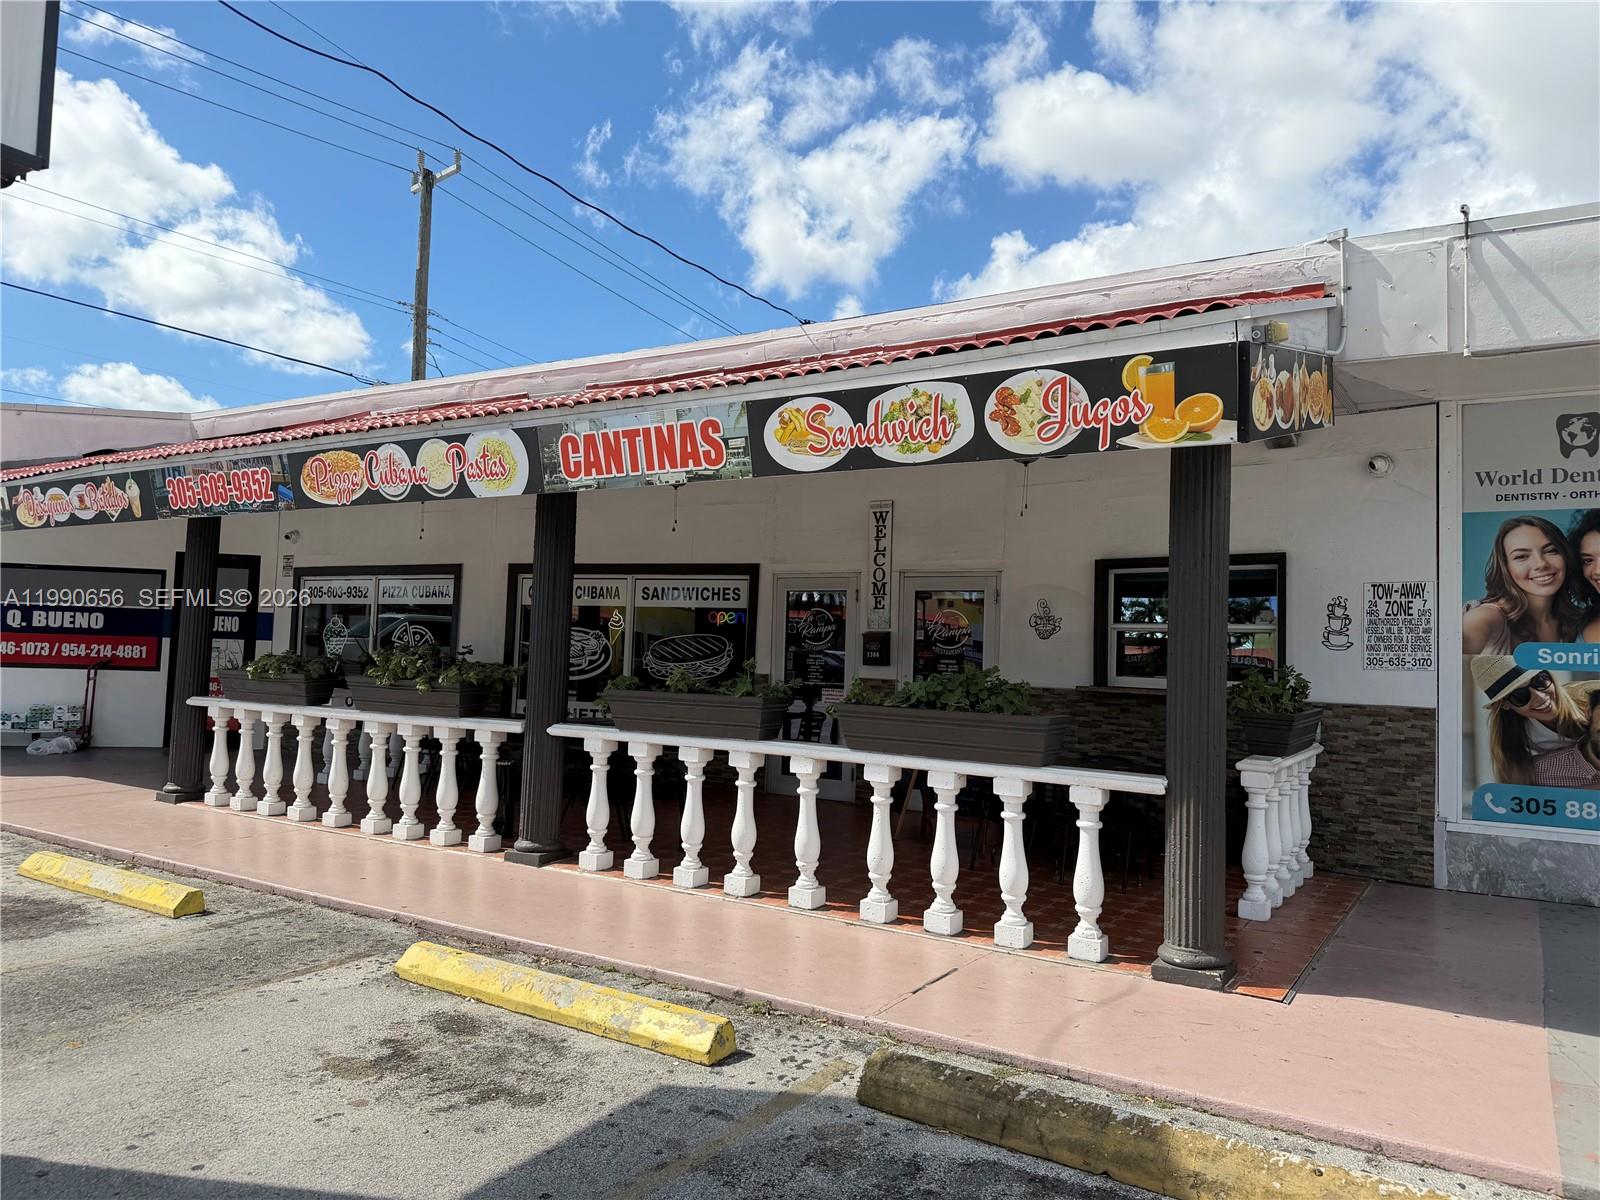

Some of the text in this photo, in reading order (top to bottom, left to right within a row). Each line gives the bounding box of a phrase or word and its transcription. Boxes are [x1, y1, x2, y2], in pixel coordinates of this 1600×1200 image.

[1036, 375, 1153, 451] Jugos
[803, 394, 956, 456] Sandwich
[559, 416, 727, 482] CANTINAS
[444, 441, 510, 485] Pastas
[309, 449, 429, 505] Pizza Cubana
[1474, 469, 1542, 487] World
[166, 467, 274, 510] 305-603-9352
[1495, 492, 1560, 502] DENTISTRY
[871, 510, 890, 610] WELCOME
[308, 585, 369, 599] 305-603-9352
[382, 585, 451, 599] PIZZA CUBANA
[575, 585, 621, 600] CUBANA
[641, 586, 741, 601] SANDWICHES
[1371, 583, 1426, 600] TOW-AWAY
[1368, 600, 1378, 608] 24
[1385, 600, 1414, 617] ZONE
[1422, 599, 1427, 608] 7
[7, 609, 104, 629] Q. BUENO
[708, 611, 745, 626] open
[1366, 609, 1379, 617] HRS
[1418, 608, 1431, 617] DAYS
[798, 621, 836, 638] Rampa
[928, 624, 972, 641] Rampa
[52, 643, 59, 656] /
[61, 643, 147, 659] 954-214-4881
[1383, 644, 1408, 652] WRECKER
[1410, 644, 1432, 652] SERVICE
[1538, 648, 1600, 665] Sonri
[1366, 657, 1432, 667] 305-635-3170
[1510, 796, 1600, 820] 305 88
